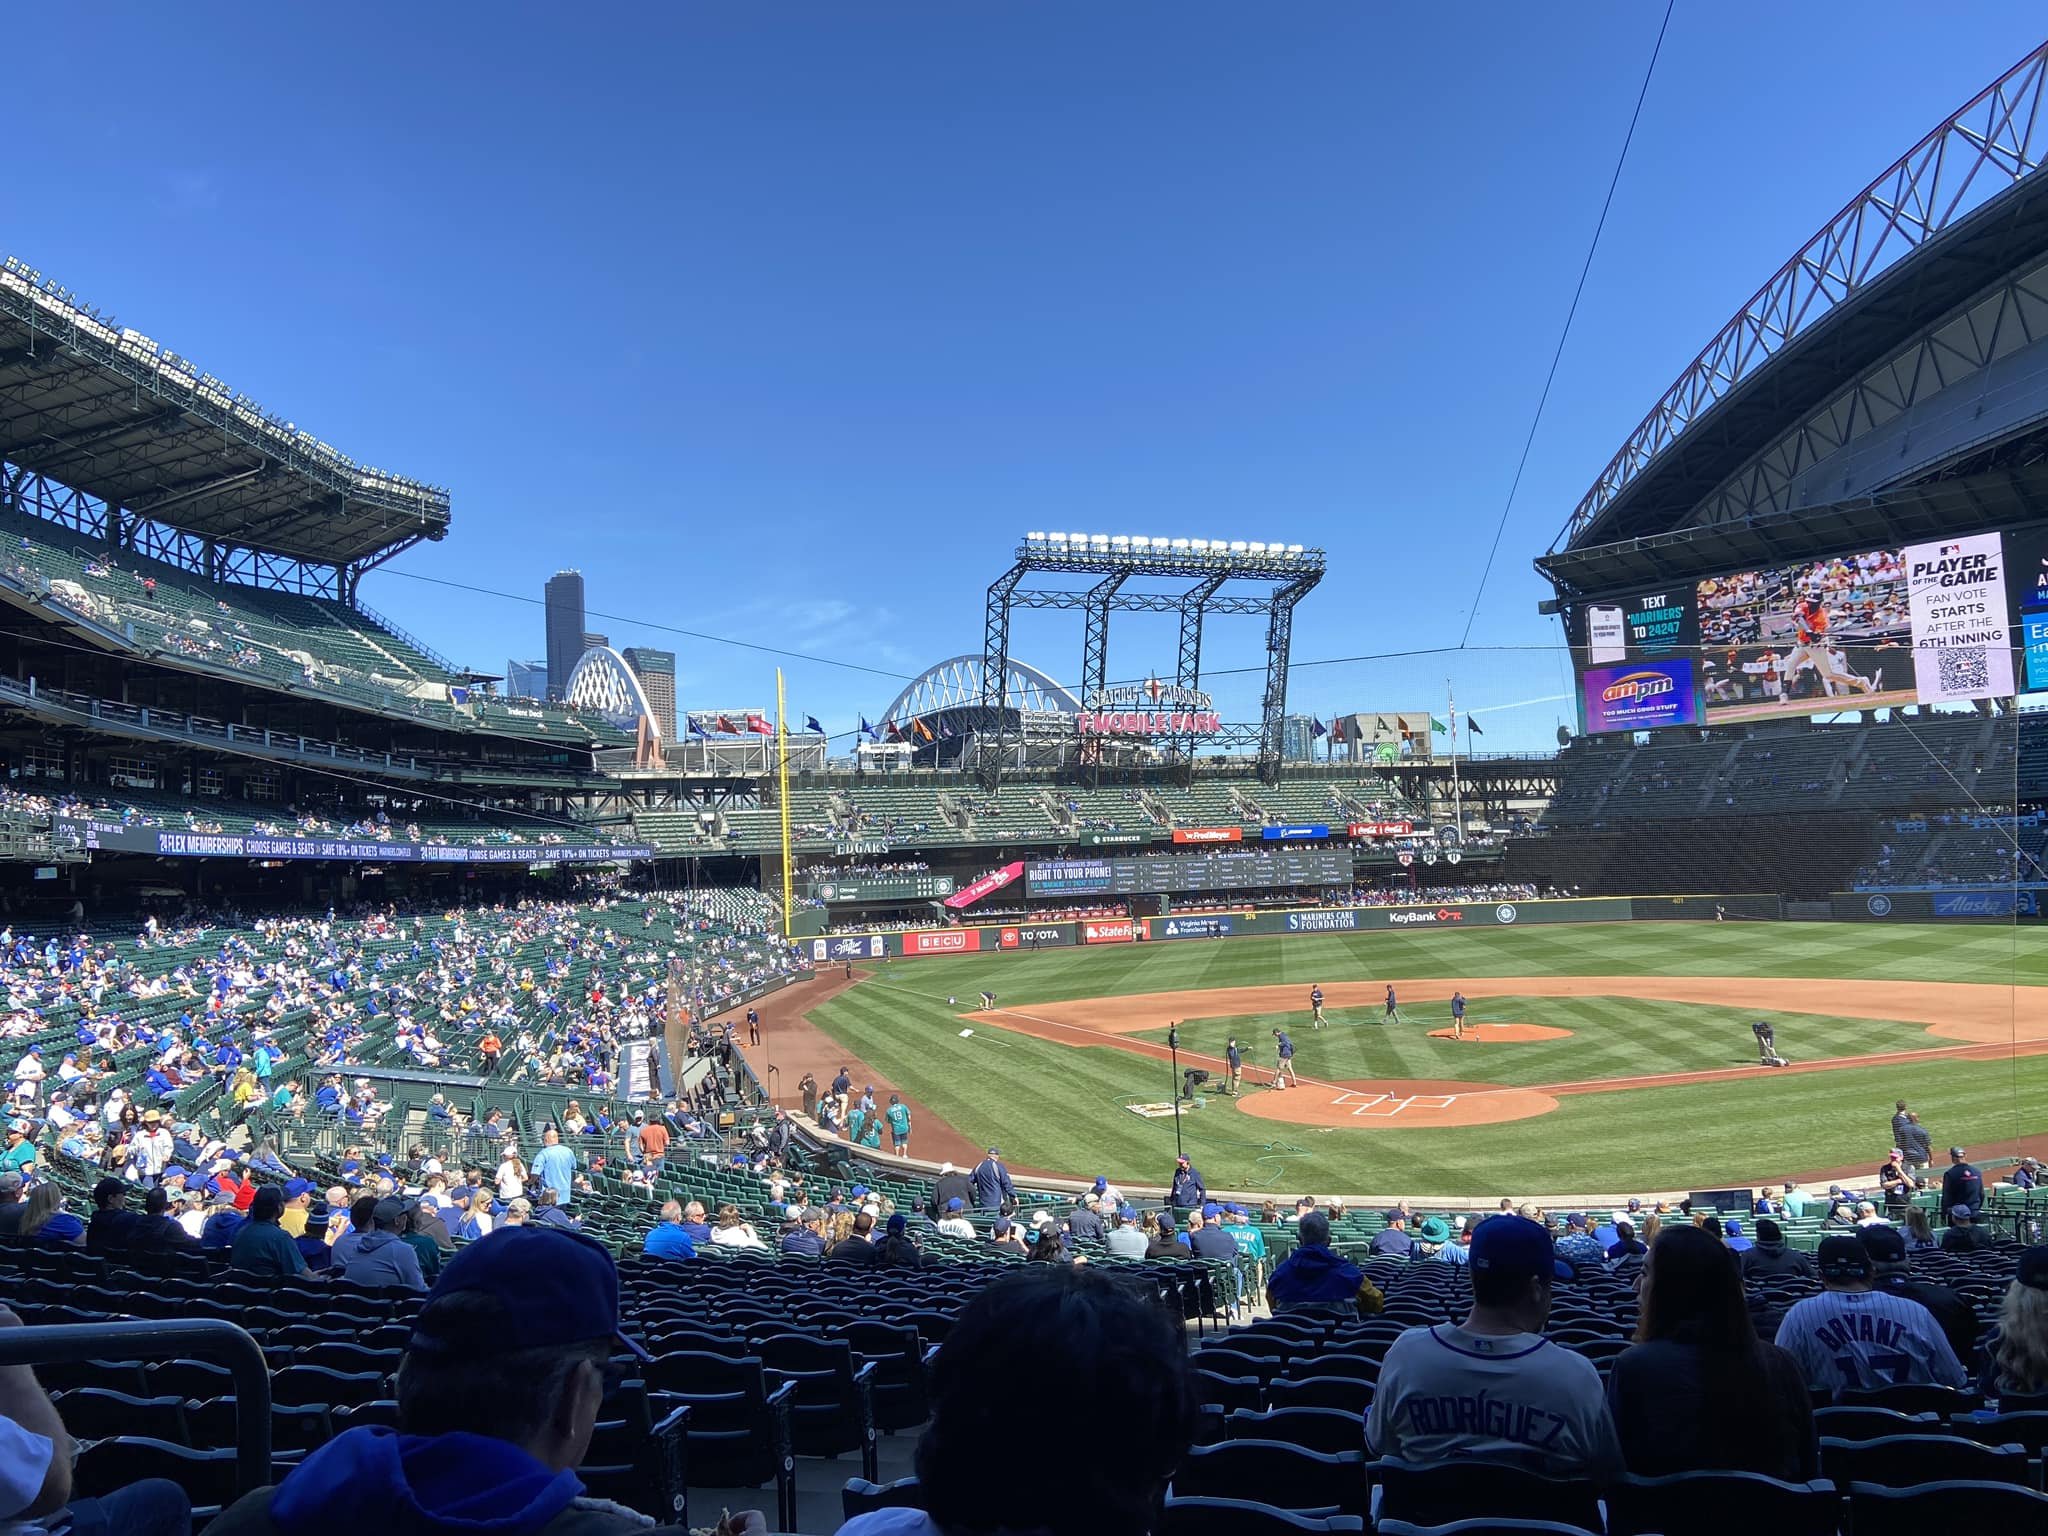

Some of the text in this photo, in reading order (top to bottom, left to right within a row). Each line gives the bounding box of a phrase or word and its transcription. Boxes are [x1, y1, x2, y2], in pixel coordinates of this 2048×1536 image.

[1913, 554, 1987, 577] PLAYER
[1912, 567, 1998, 588] OF THE GAME
[1642, 595, 1667, 609] TEXT
[1926, 588, 1988, 605] FAN VOTE
[1930, 603, 1986, 619] STARTS
[1633, 621, 1680, 639] TO 24247
[1926, 617, 1993, 633] AFTER THE
[1919, 630, 2003, 649] 6TH INNING
[1091, 685, 1212, 708] SEATTLE MARINERS
[1603, 677, 1674, 703] ampm
[1603, 709, 1616, 717] TOO
[1656, 703, 1678, 711] STUFF
[1076, 711, 1222, 734] T-MOBILE PARK
[160, 834, 168, 851] 24
[168, 835, 186, 852] FLEX
[187, 836, 244, 854] MEMBERSHIPS
[246, 840, 271, 854] CHOOSE
[271, 842, 292, 854] GAMES
[292, 842, 298, 854] &
[297, 842, 315, 855] SEATS
[322, 844, 335, 856] SAVE
[351, 845, 359, 856] ON
[359, 845, 377, 857] TICKETS
[469, 850, 487, 860] CHOOSE
[489, 850, 510, 860] GAMES
[512, 849, 517, 859] &
[518, 849, 537, 859] SEATS
[545, 849, 560, 859] SAVE
[578, 849, 586, 858] ON
[587, 849, 609, 858] TICKETS
[1029, 869, 1051, 881] RIGHT
[1053, 868, 1062, 880] TO
[1063, 867, 1084, 879] YOUR
[1085, 866, 1112, 878] PHONE!
[1939, 897, 2001, 914] Alaska
[1179, 920, 1200, 928] Virginia
[1301, 911, 1354, 921] MARINERS CARE
[1389, 912, 1436, 924] KeyBank
[1301, 919, 1354, 930] FOUNDATION
[922, 937, 962, 948] BECU
[893, 1111, 903, 1120] 19
[1815, 1313, 1907, 1351] BRYANT
[1408, 1388, 1568, 1447] RODRÍGUEZ
